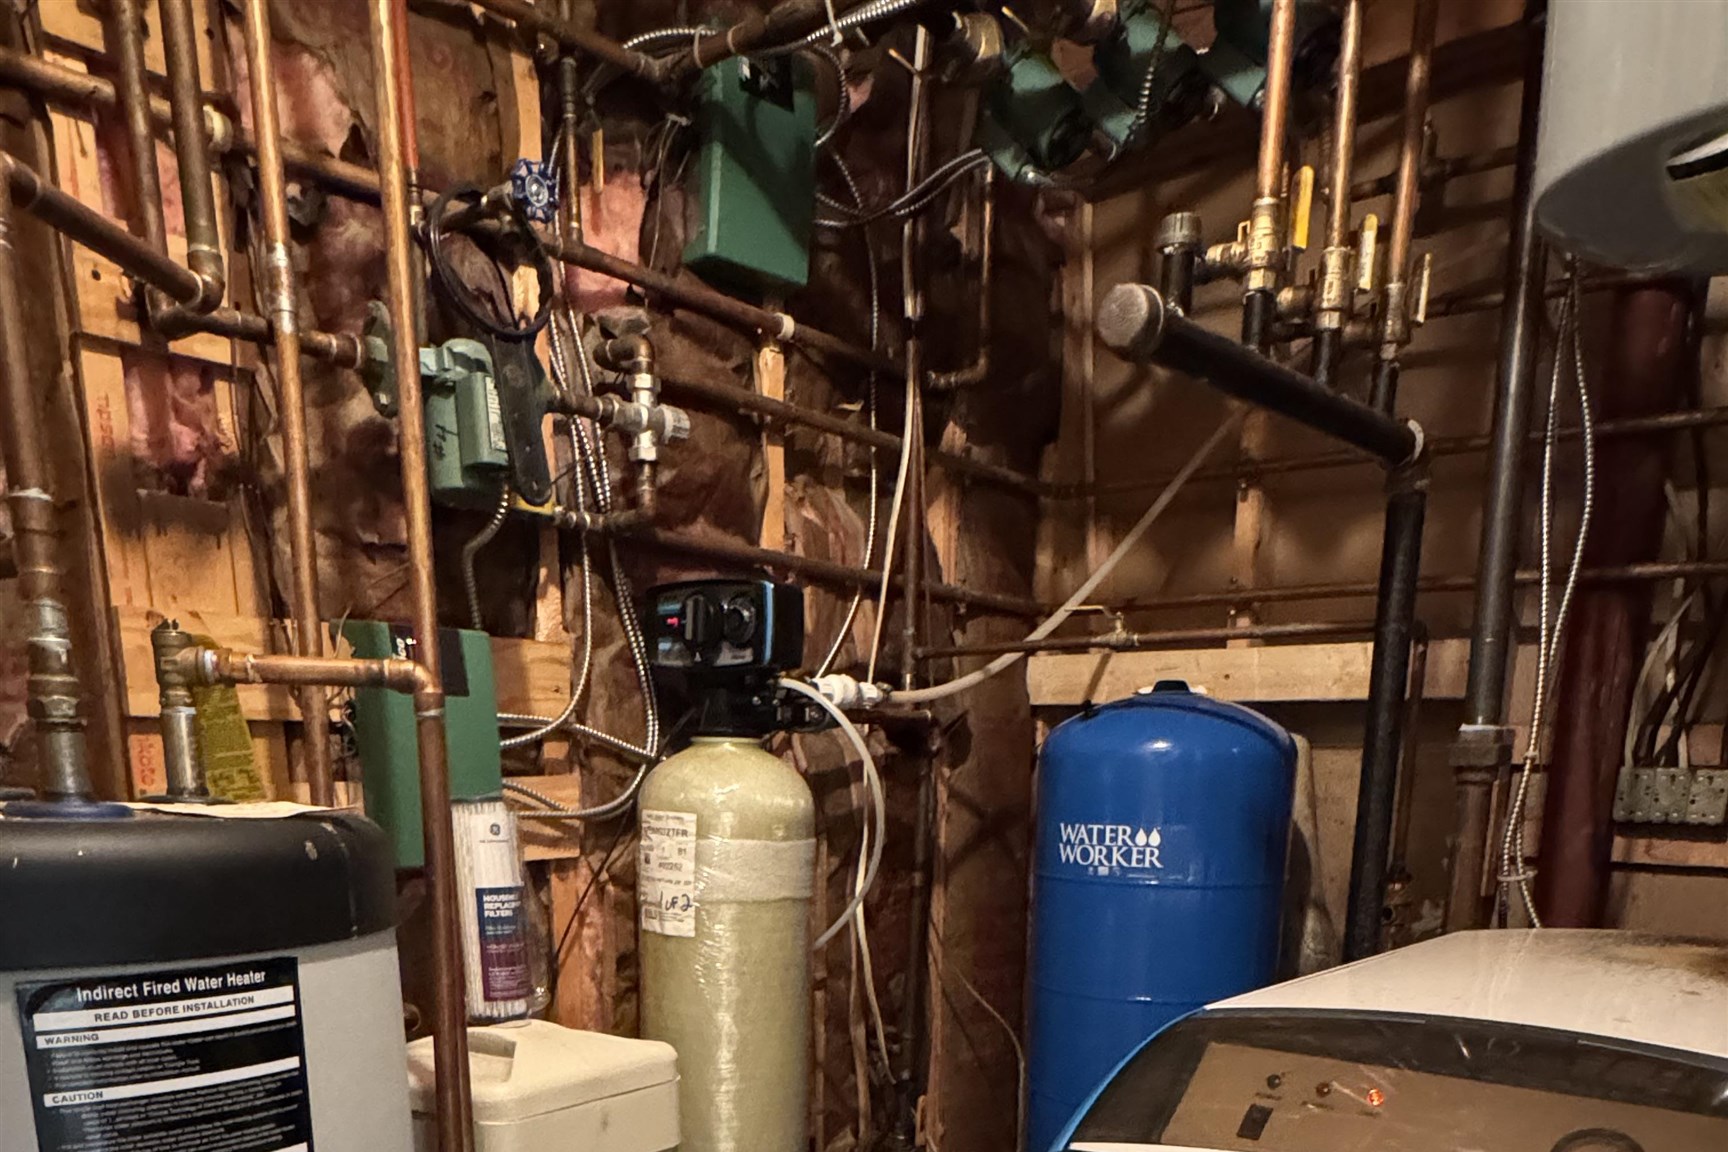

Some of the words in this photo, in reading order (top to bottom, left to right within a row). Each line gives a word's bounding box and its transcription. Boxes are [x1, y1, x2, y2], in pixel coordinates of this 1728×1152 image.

[1060, 823, 1134, 846] WATER
[1059, 843, 1164, 868] WORKER
[77, 984, 139, 1003] Indirect
[143, 979, 181, 997] Fired
[184, 974, 224, 992] Water
[227, 970, 266, 987] Heater
[94, 1010, 129, 1023] READ
[132, 1004, 180, 1019] BEFORE
[182, 995, 255, 1014] INSTALLATION
[44, 1033, 100, 1046] WARNING
[52, 1091, 104, 1104] CAUTION
